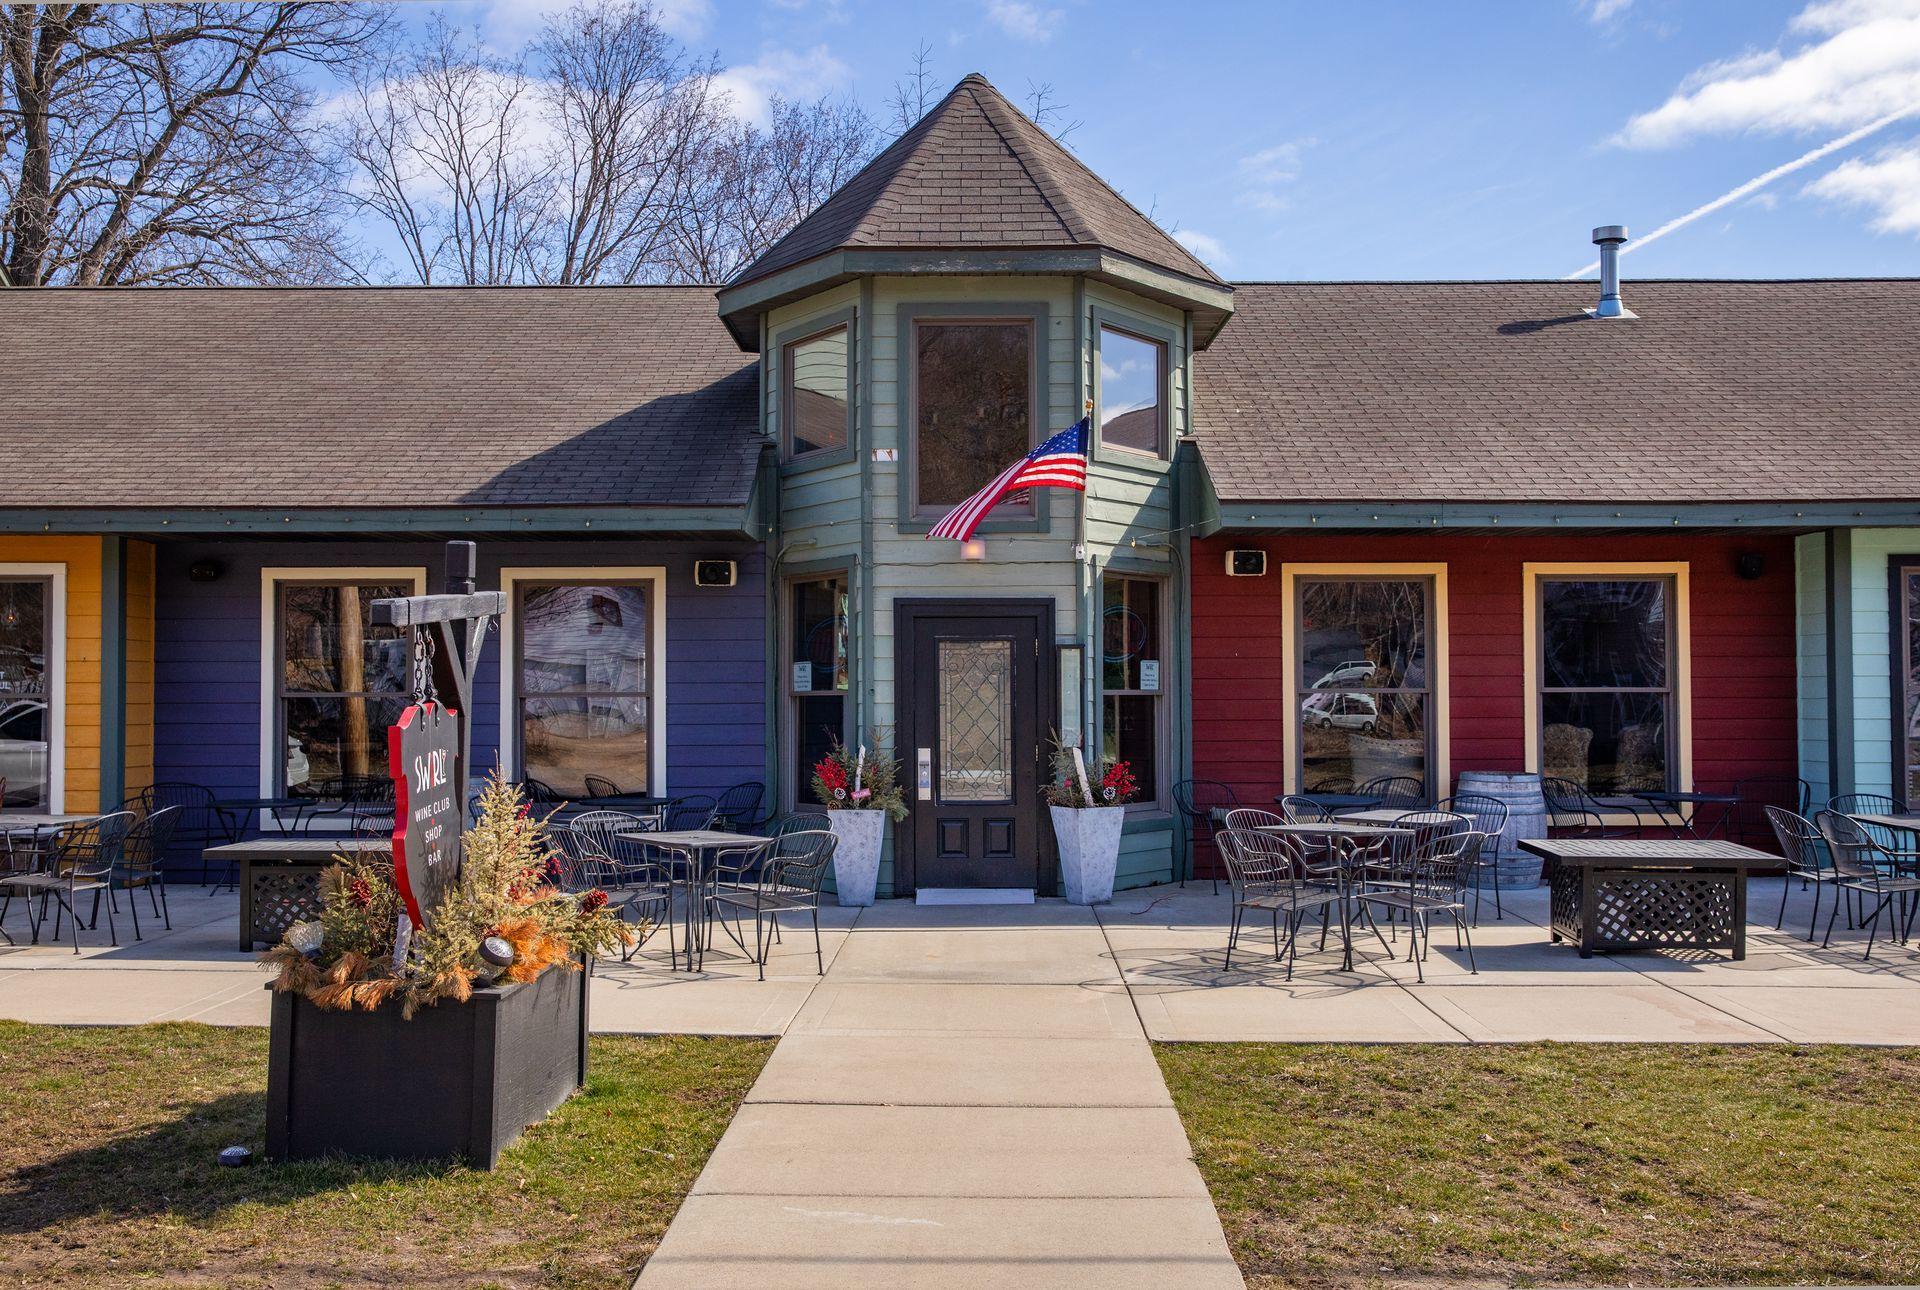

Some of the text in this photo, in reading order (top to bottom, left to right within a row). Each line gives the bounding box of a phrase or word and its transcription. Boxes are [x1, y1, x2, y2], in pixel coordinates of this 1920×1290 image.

[415, 749, 447, 794] SWIRL
[415, 797, 450, 823] WINE CLUB
[425, 825, 442, 843] SHOP
[428, 850, 442, 866] BAR
